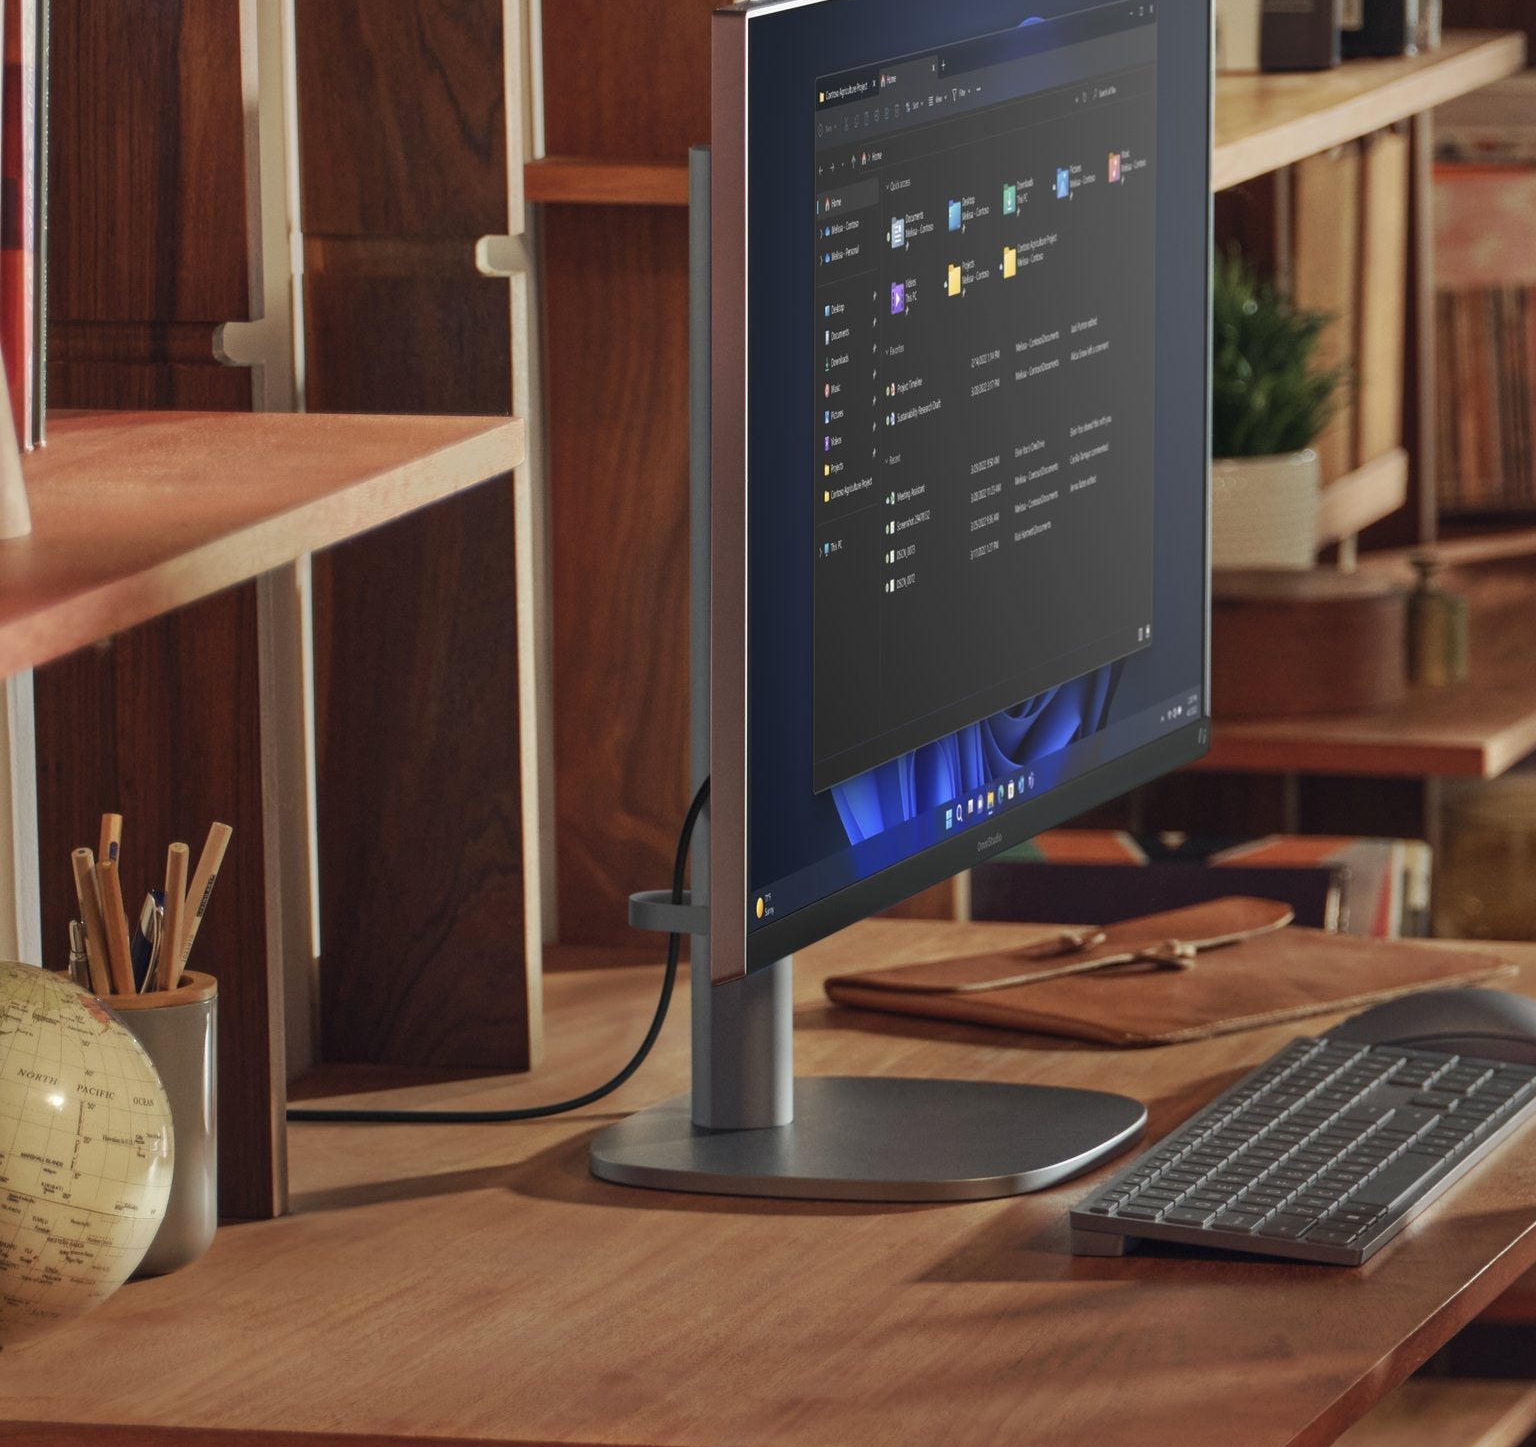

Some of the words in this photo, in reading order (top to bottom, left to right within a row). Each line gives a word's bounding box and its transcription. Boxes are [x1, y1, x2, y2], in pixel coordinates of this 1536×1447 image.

[887, 75, 897, 84] Home
[872, 152, 882, 161] Home
[831, 197, 842, 207] Home
[831, 304, 845, 315] Desktop
[831, 328, 850, 340] Documents
[831, 355, 849, 368] Downloads
[831, 410, 844, 420] Pictures
[831, 462, 844, 474] Projects
[977, 833, 1002, 852] OmniStudio
[17, 1068, 58, 1086] NORTH
[76, 1084, 116, 1100] PACIFIC
